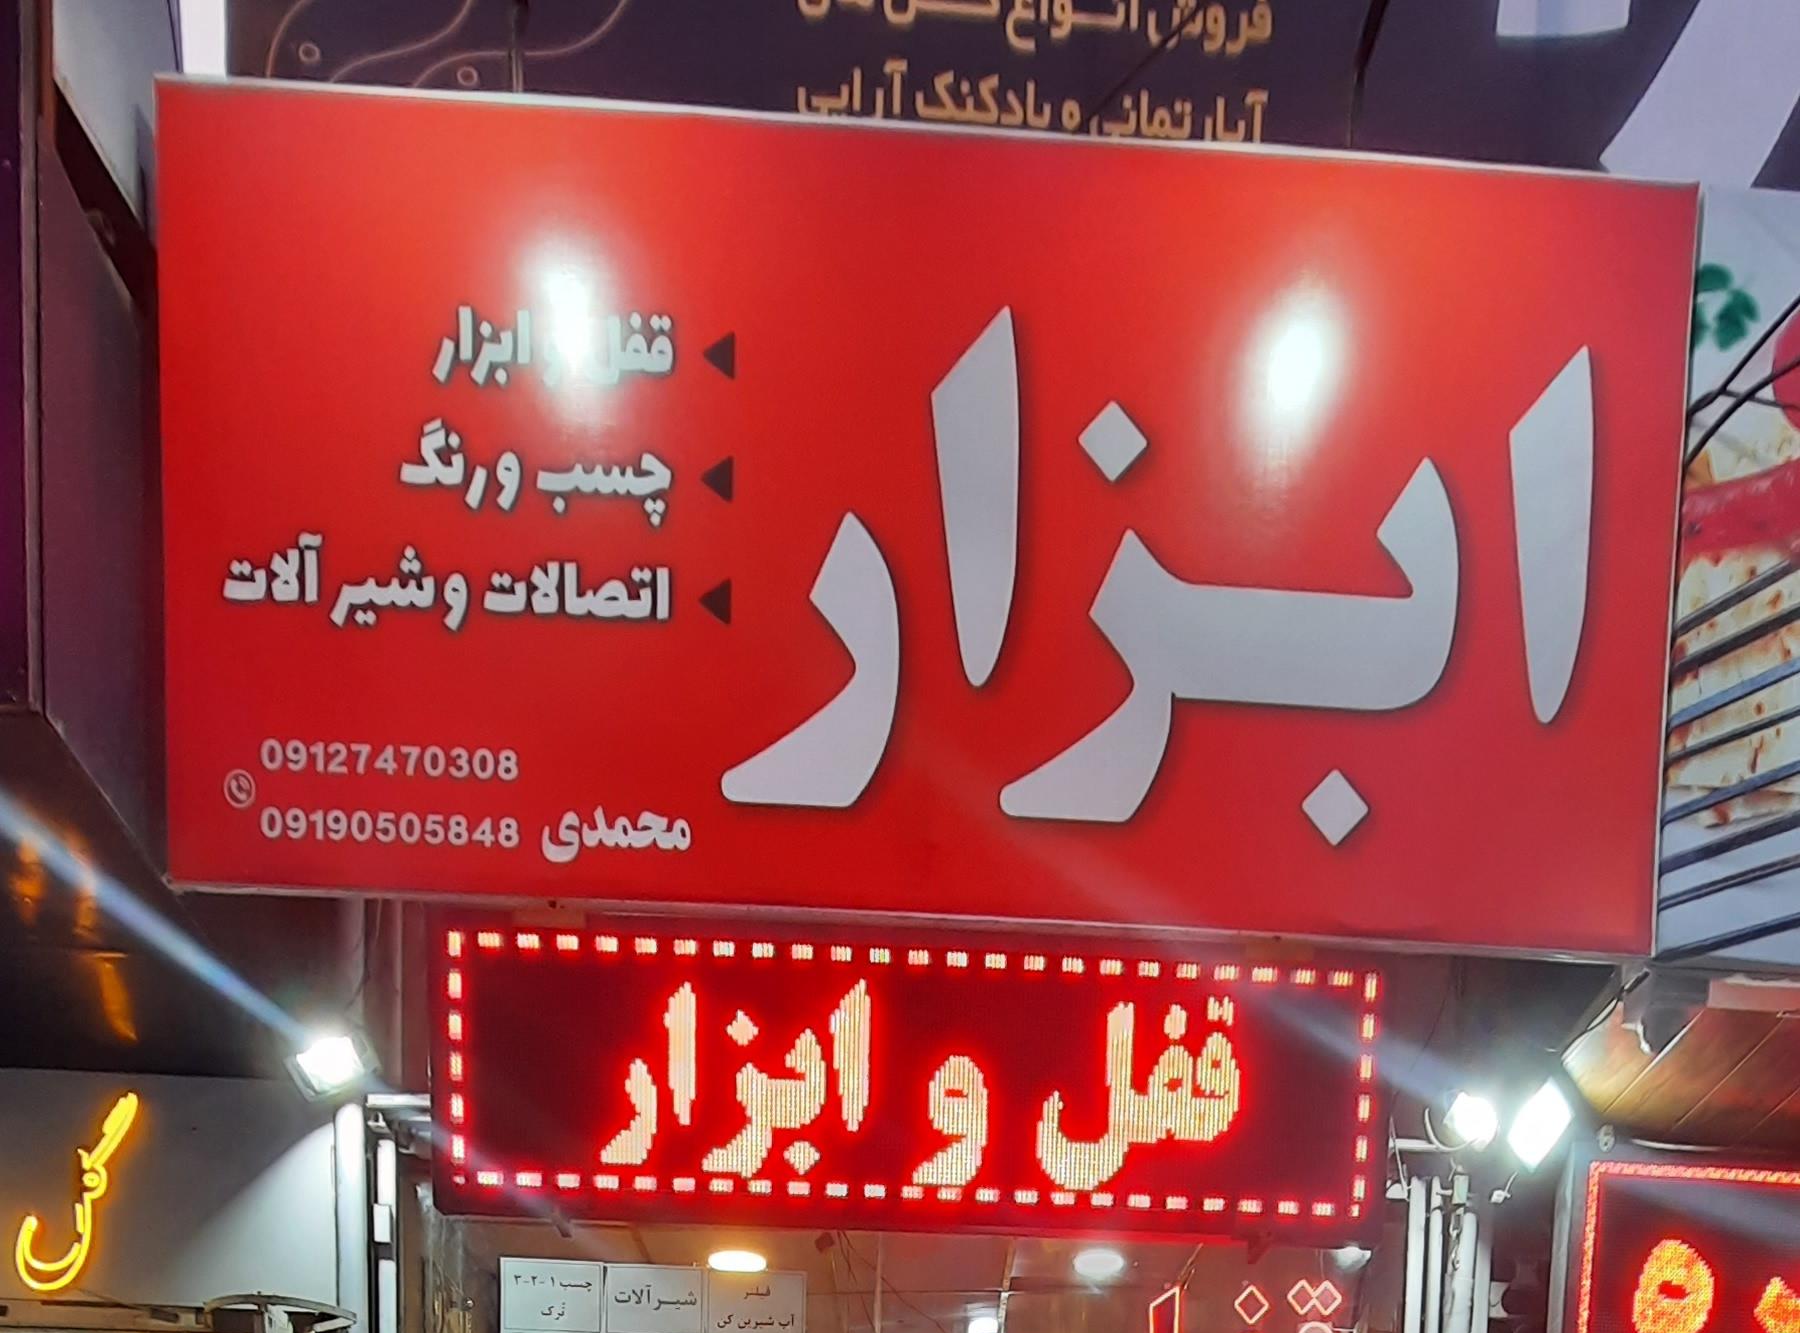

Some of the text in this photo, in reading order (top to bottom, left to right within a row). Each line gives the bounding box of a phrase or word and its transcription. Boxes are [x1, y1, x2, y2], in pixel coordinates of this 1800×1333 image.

[431, 305, 532, 386] ابزار
[584, 311, 675, 386] قفل
[400, 417, 487, 511] رنگ
[536, 450, 673, 528] چسب
[222, 532, 322, 603] آلات
[328, 545, 437, 628] شیر
[483, 560, 670, 621] اتصالات
[721, 305, 1594, 846] ابزار
[259, 737, 520, 781] 09127470308
[259, 806, 520, 848] 09190505848
[541, 804, 692, 864] محمدی
[599, 977, 1242, 1192] قفل و ابزار
[559, 1280, 593, 1293] چسب
